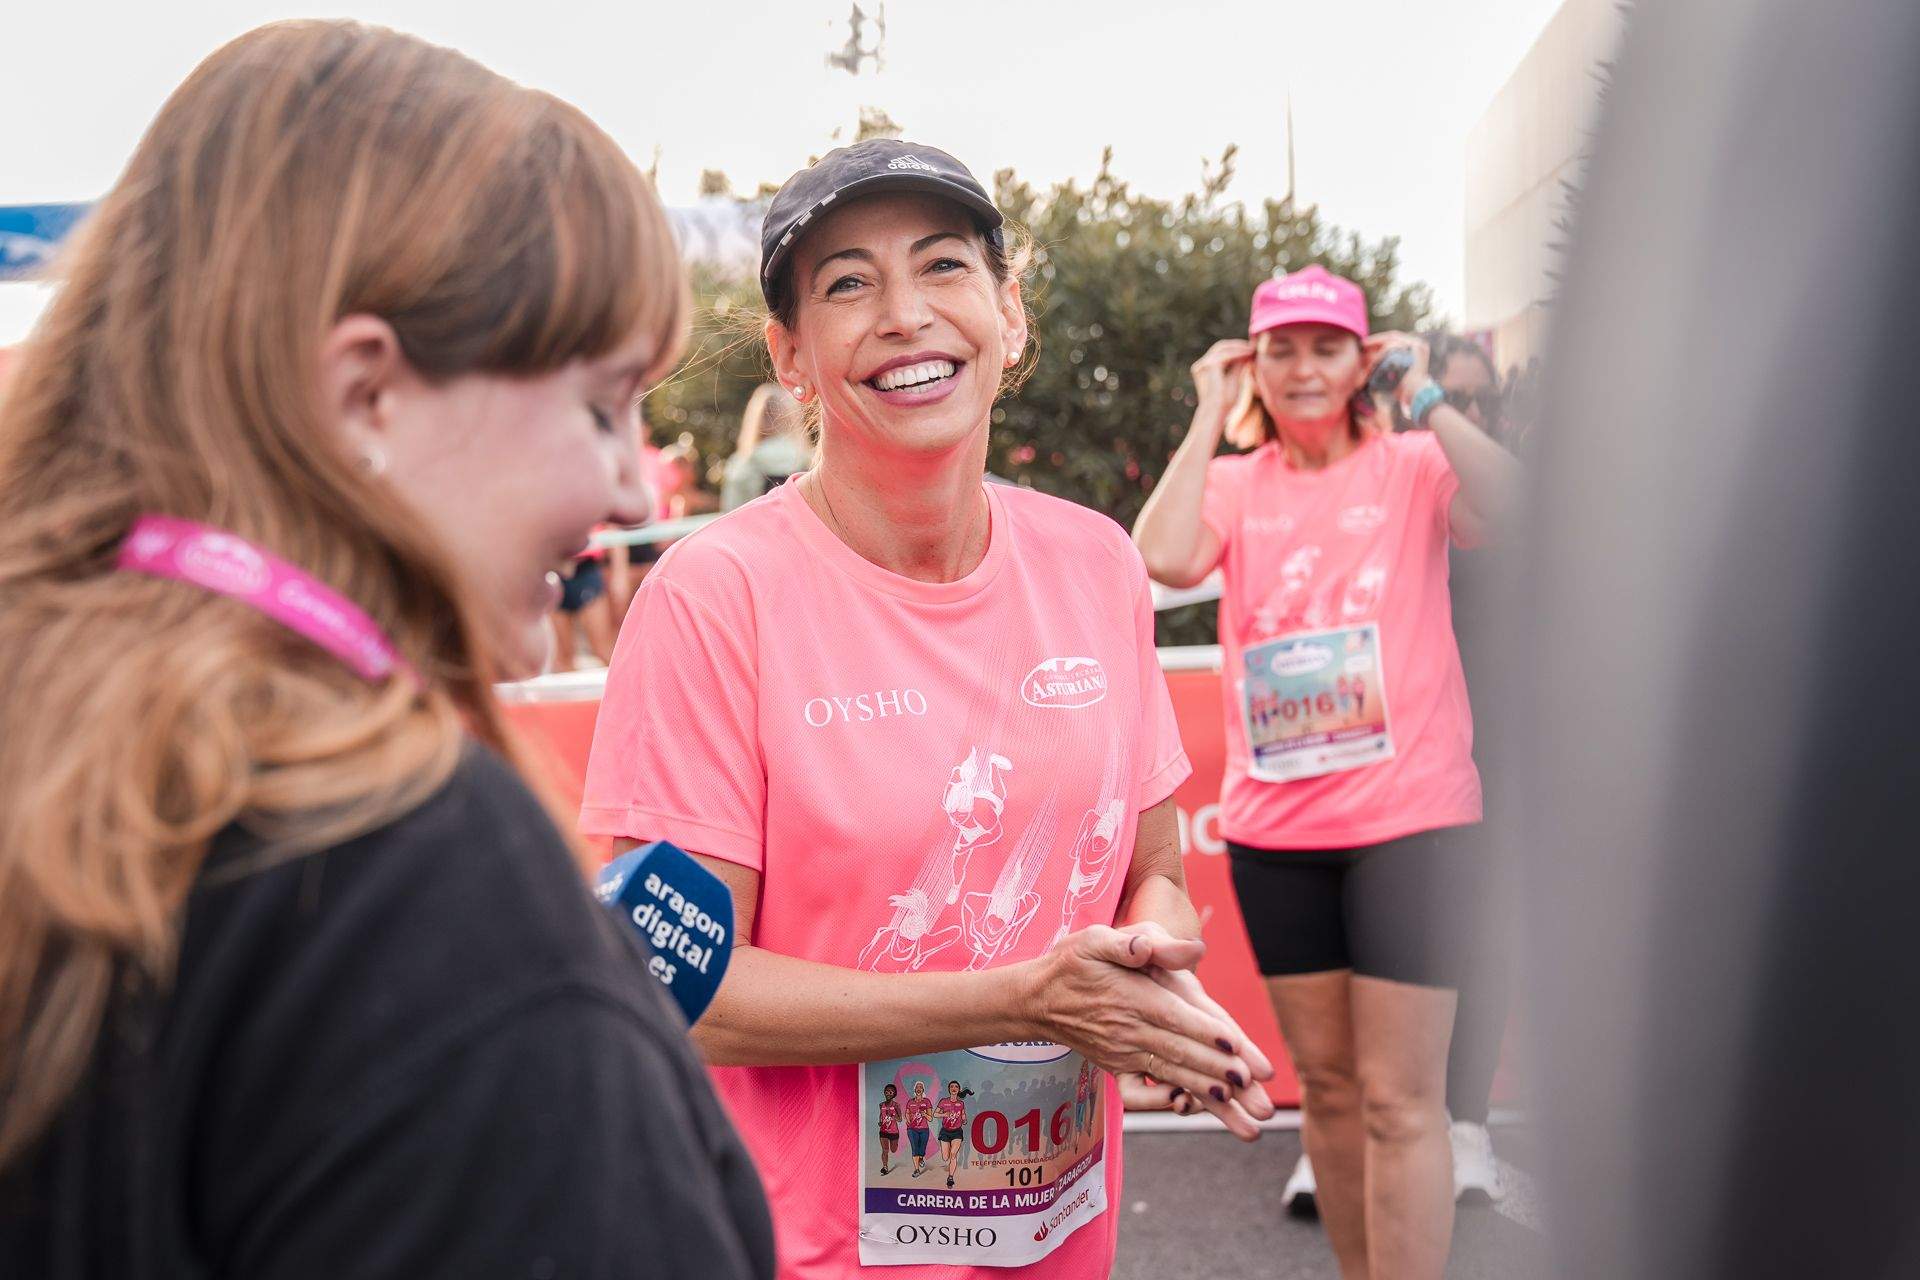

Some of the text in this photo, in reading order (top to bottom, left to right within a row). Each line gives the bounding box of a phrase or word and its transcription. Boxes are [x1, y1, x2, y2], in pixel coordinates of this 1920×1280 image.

[804, 688, 928, 727] OYSHO
[1281, 692, 1335, 721] 016
[644, 873, 726, 945] aragon
[632, 903, 713, 974] digital
[971, 1102, 1072, 1155] 016
[1005, 1166, 1043, 1187] 101
[897, 1194, 964, 1209] CARRERA
[969, 1196, 988, 1209] DE
[992, 1195, 1010, 1209] LA
[1015, 1187, 1055, 1208] MUJER
[896, 1225, 997, 1248] OYSHO
